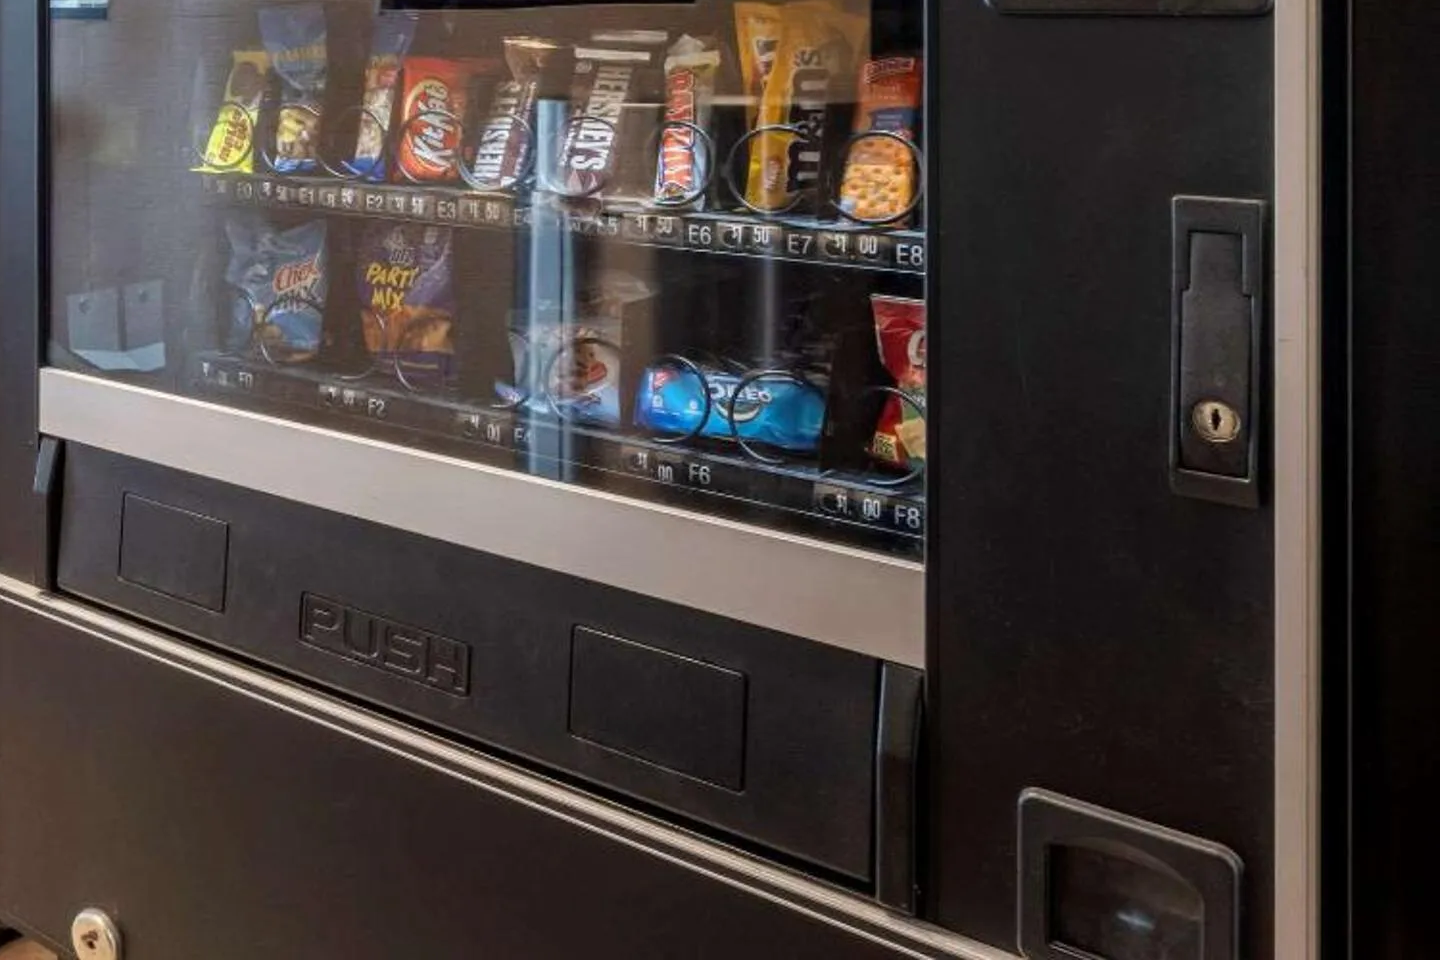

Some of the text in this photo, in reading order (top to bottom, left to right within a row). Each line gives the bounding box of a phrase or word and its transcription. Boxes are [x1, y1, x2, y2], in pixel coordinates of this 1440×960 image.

[570, 66, 632, 171] HERSHEY'S
[438, 200, 456, 219] E3
[688, 224, 711, 244] E6
[788, 234, 811, 254] E7
[896, 242, 923, 266] E8
[366, 262, 420, 289] PARTY
[371, 288, 404, 311] MIX
[368, 398, 387, 419] F2
[689, 464, 711, 486] F6
[895, 504, 921, 530] F8
[300, 591, 472, 696] PUSH
